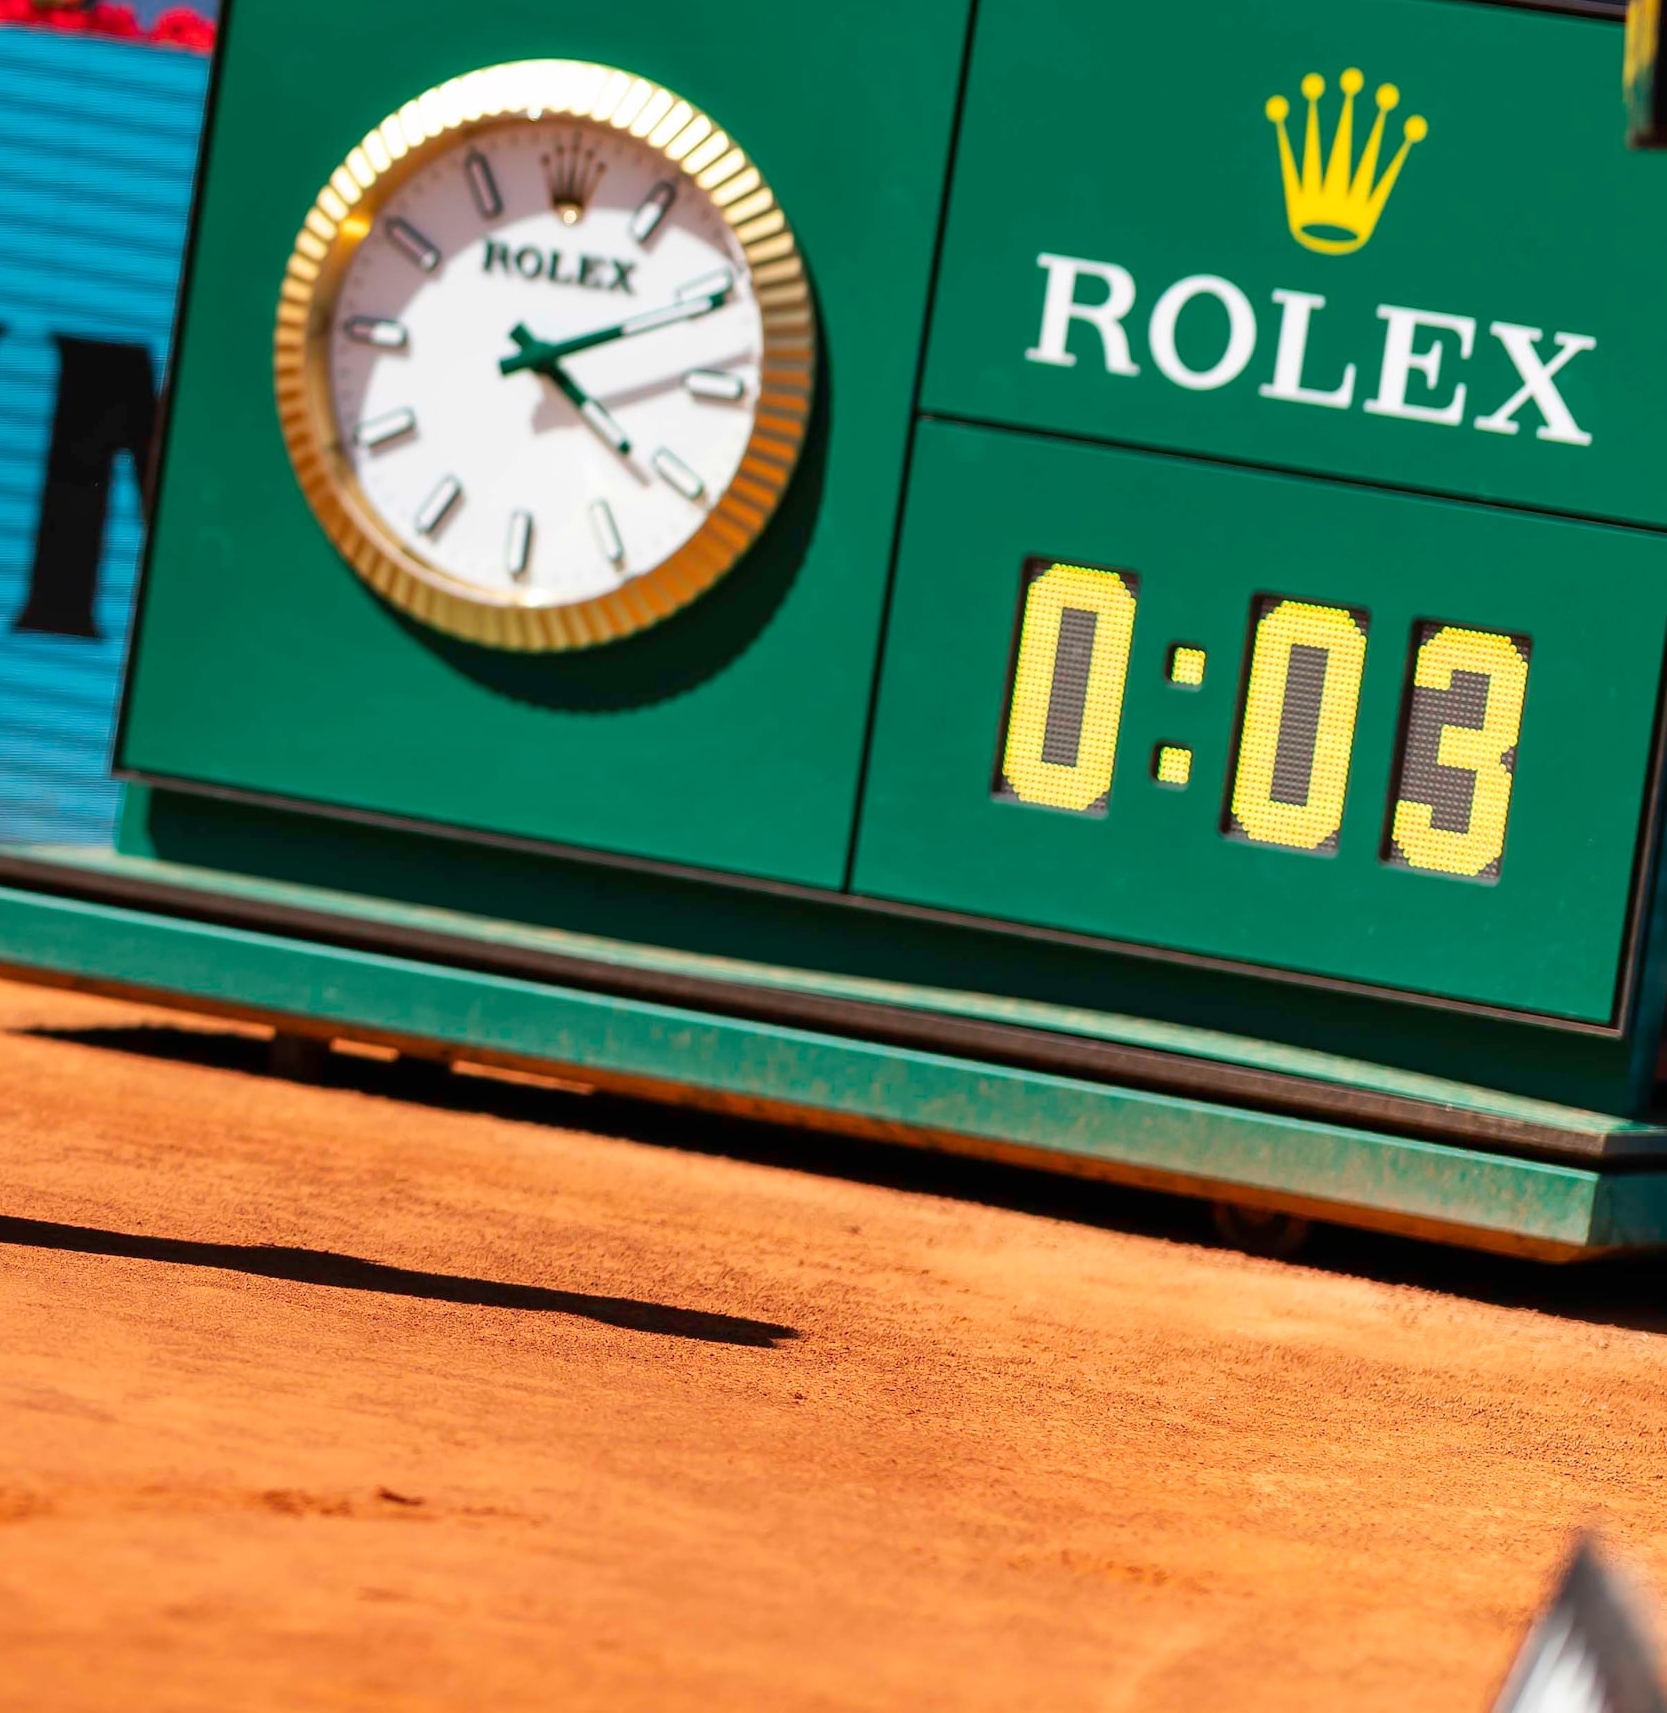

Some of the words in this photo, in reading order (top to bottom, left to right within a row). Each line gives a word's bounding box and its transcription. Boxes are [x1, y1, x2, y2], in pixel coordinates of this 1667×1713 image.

[483, 239, 636, 295] ROLEX
[1024, 253, 1597, 446] ROLEX
[1002, 562, 1530, 878] 0:03
